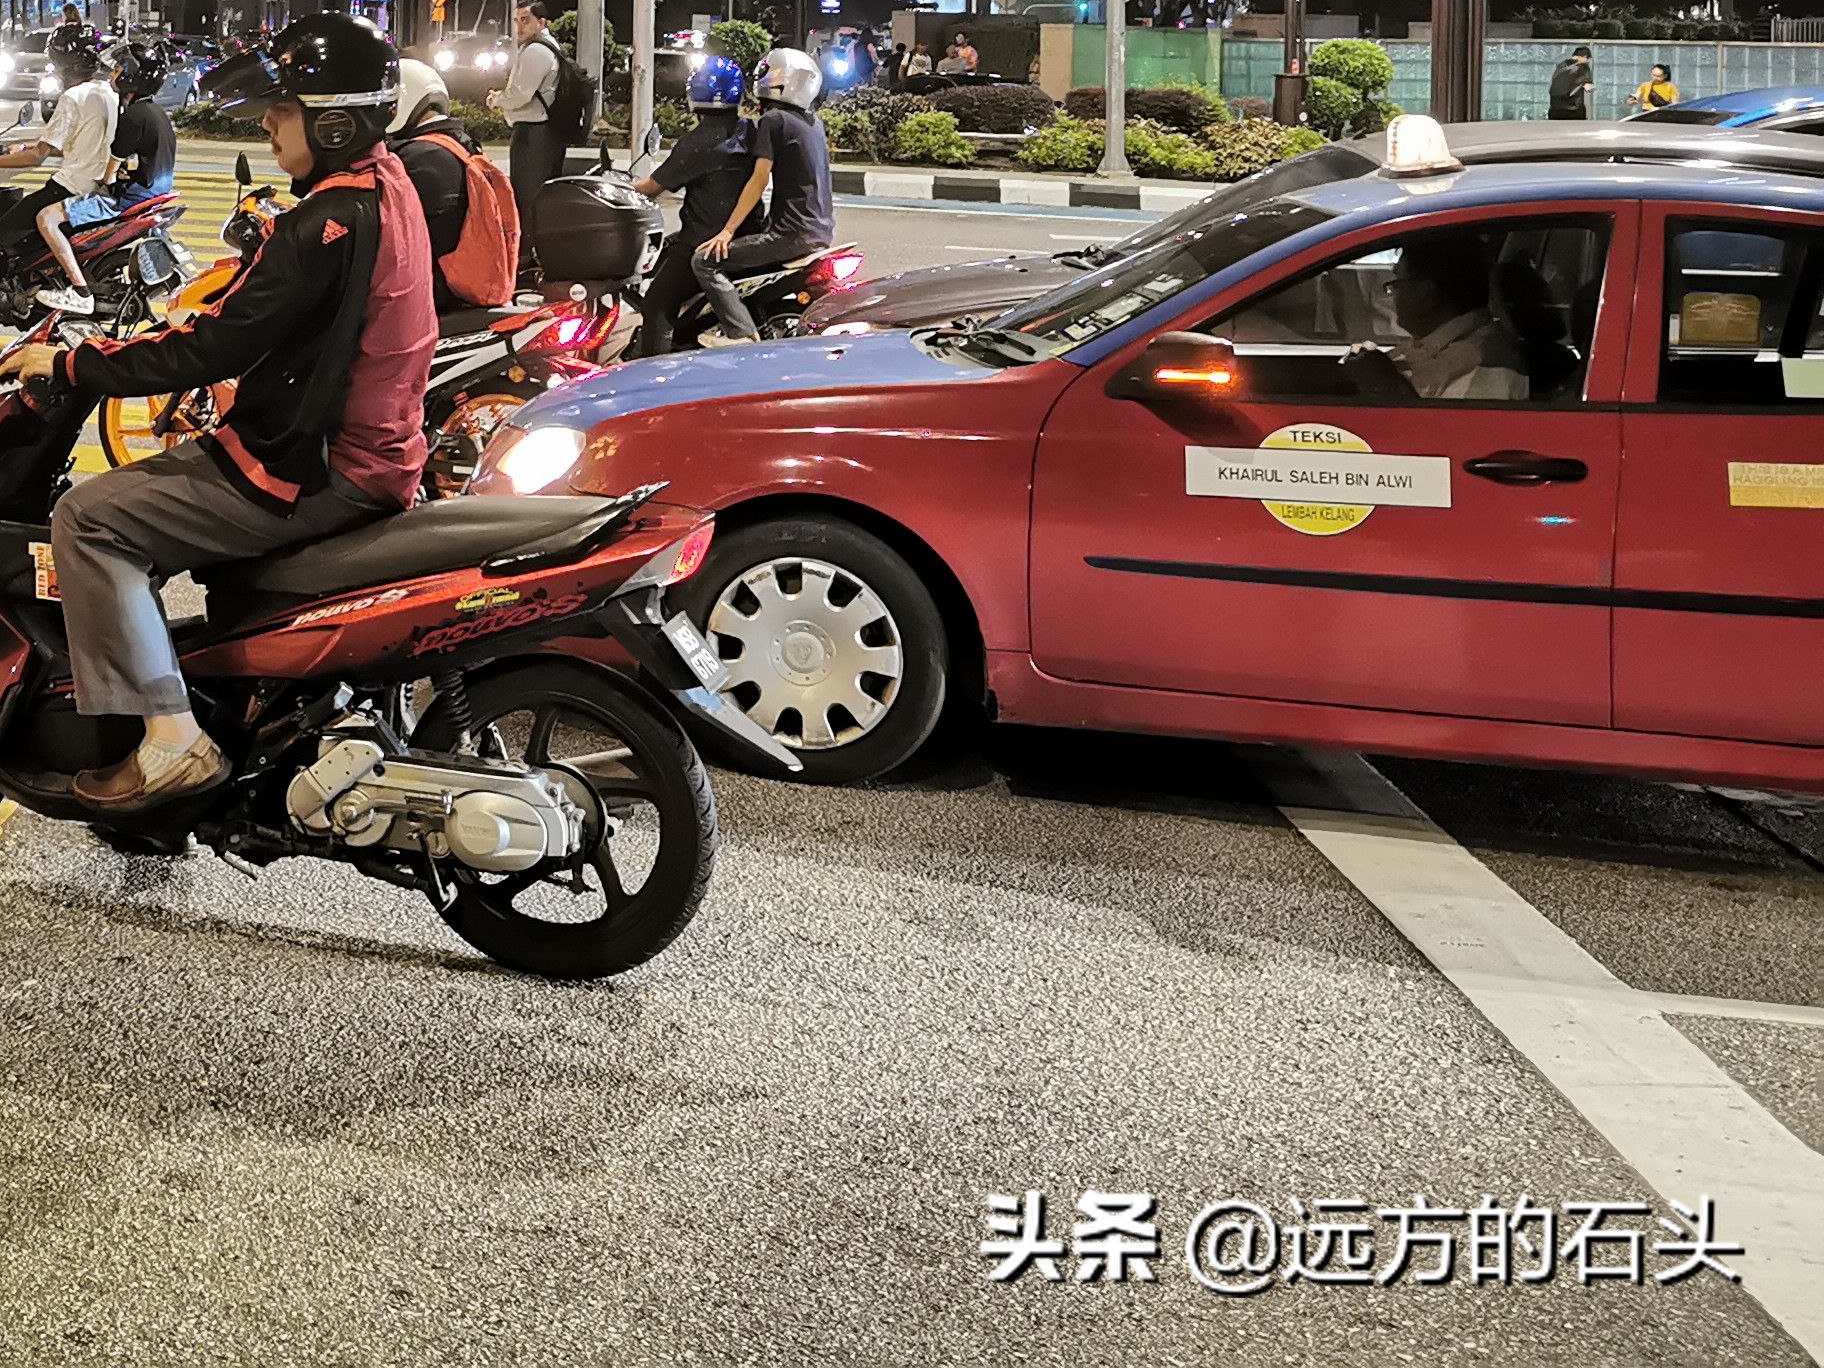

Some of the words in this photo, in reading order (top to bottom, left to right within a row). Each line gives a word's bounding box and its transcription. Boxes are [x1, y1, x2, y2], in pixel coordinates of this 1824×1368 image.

[1289, 430, 1342, 444] TEKSI
[1218, 466, 1283, 484] KHAIRUL
[1289, 470, 1339, 485] SALEH
[1345, 473, 1369, 487] BIN
[1376, 474, 1412, 489] ALWI
[1281, 504, 1318, 520] LEMBAH
[1319, 506, 1355, 522] KELANG
